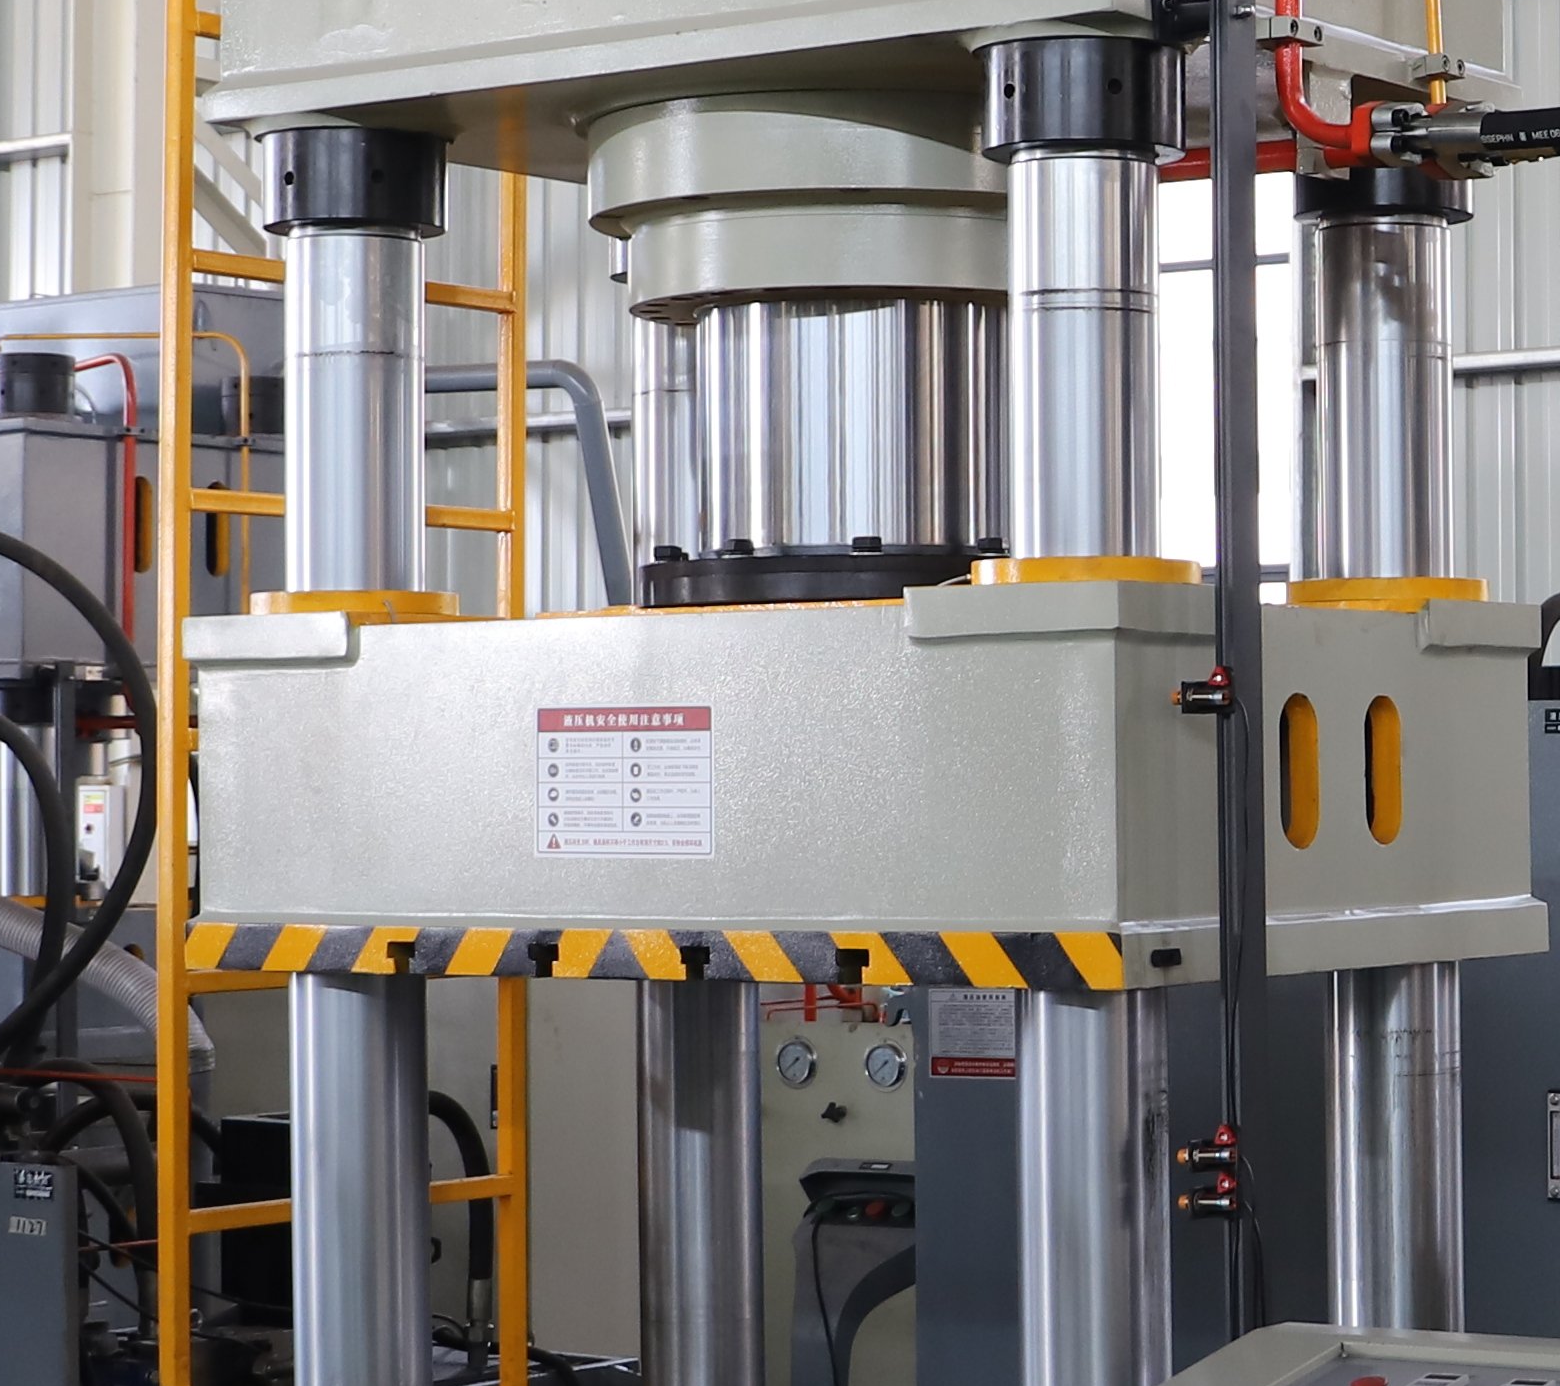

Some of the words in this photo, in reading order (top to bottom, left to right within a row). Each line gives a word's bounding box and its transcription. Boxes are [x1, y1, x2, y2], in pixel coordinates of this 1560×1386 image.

[563, 712, 685, 727] 液压机安全使用注意事项
